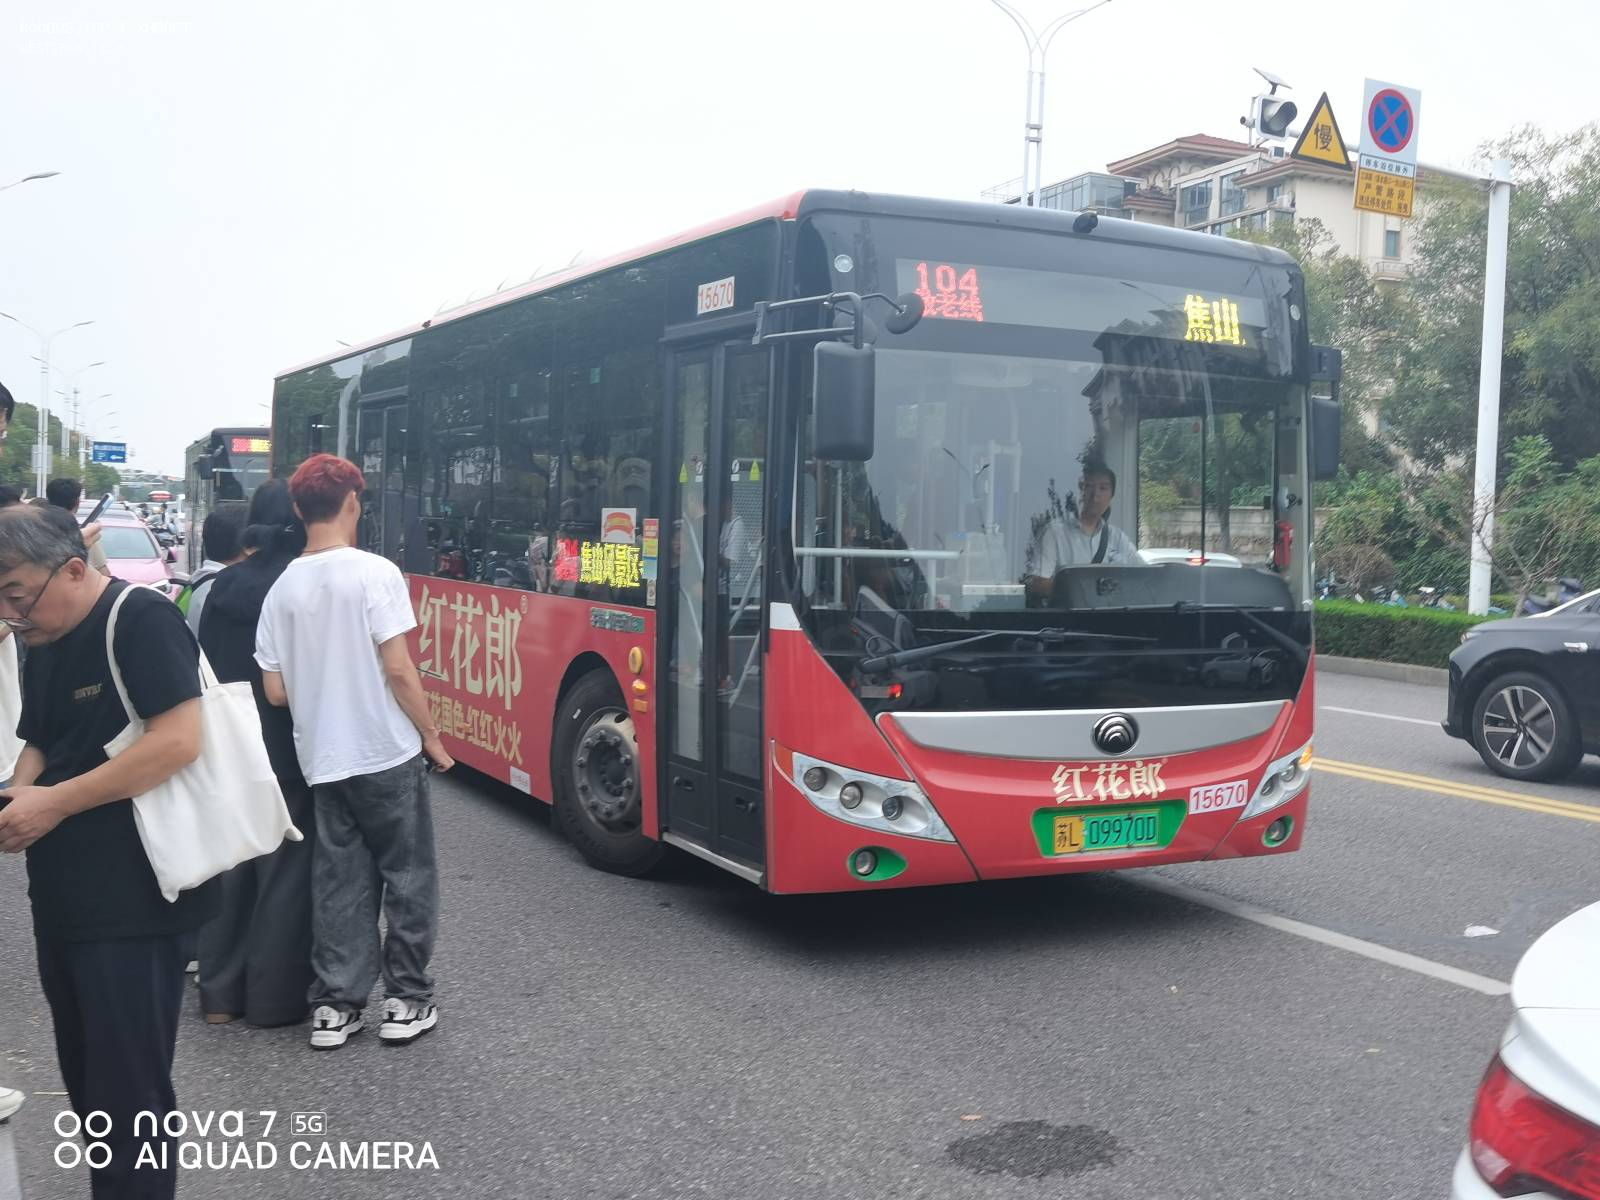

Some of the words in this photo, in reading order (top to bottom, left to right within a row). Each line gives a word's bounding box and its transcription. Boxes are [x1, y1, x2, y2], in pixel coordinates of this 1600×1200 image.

[1314, 122, 1333, 151] 慢
[699, 282, 733, 311] 15670
[914, 262, 979, 297] 104
[1184, 294, 1240, 344] 焦山
[418, 584, 523, 711] 红花郎
[1051, 761, 1167, 804] 红花郎
[1193, 783, 1245, 810] 15670
